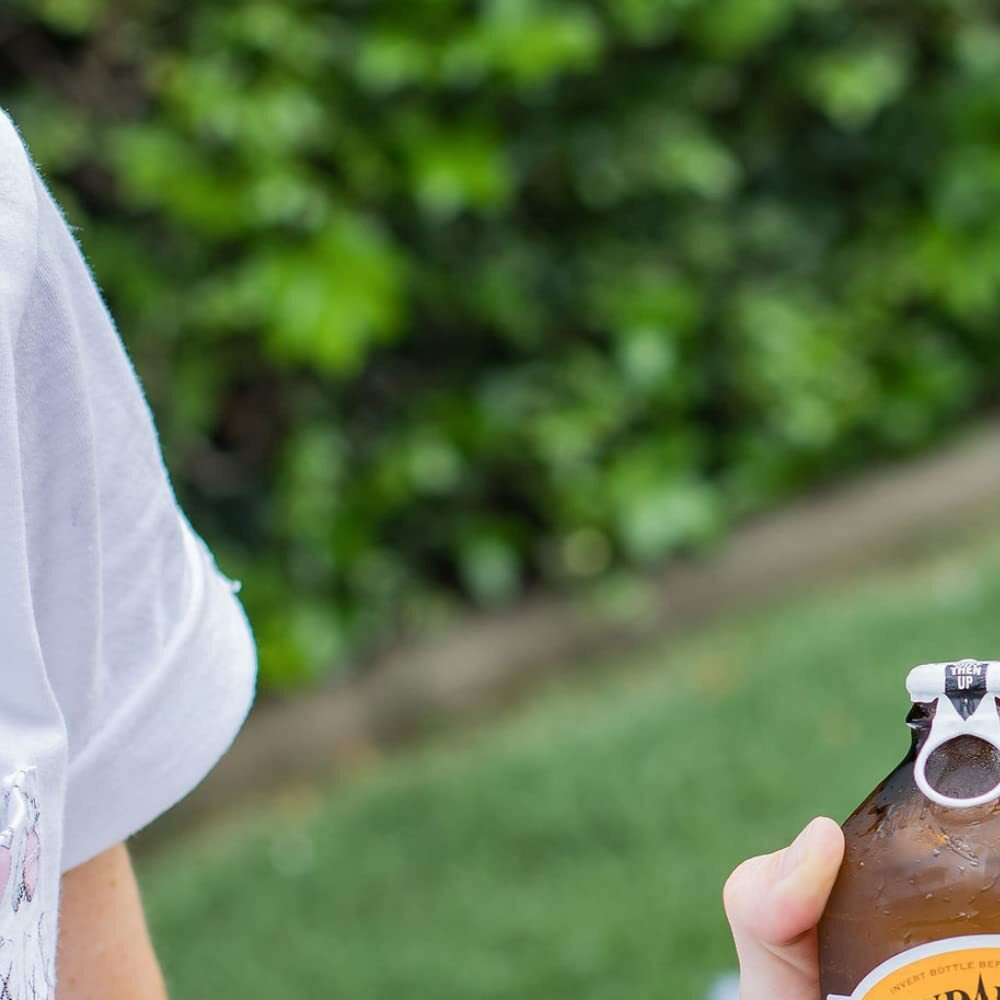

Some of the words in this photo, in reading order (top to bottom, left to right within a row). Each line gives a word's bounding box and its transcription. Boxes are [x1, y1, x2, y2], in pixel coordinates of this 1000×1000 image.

[951, 663, 982, 676] THEN
[957, 675, 973, 690] UP
[890, 972, 926, 995] INVERT
[929, 961, 975, 977] BOTTLE
